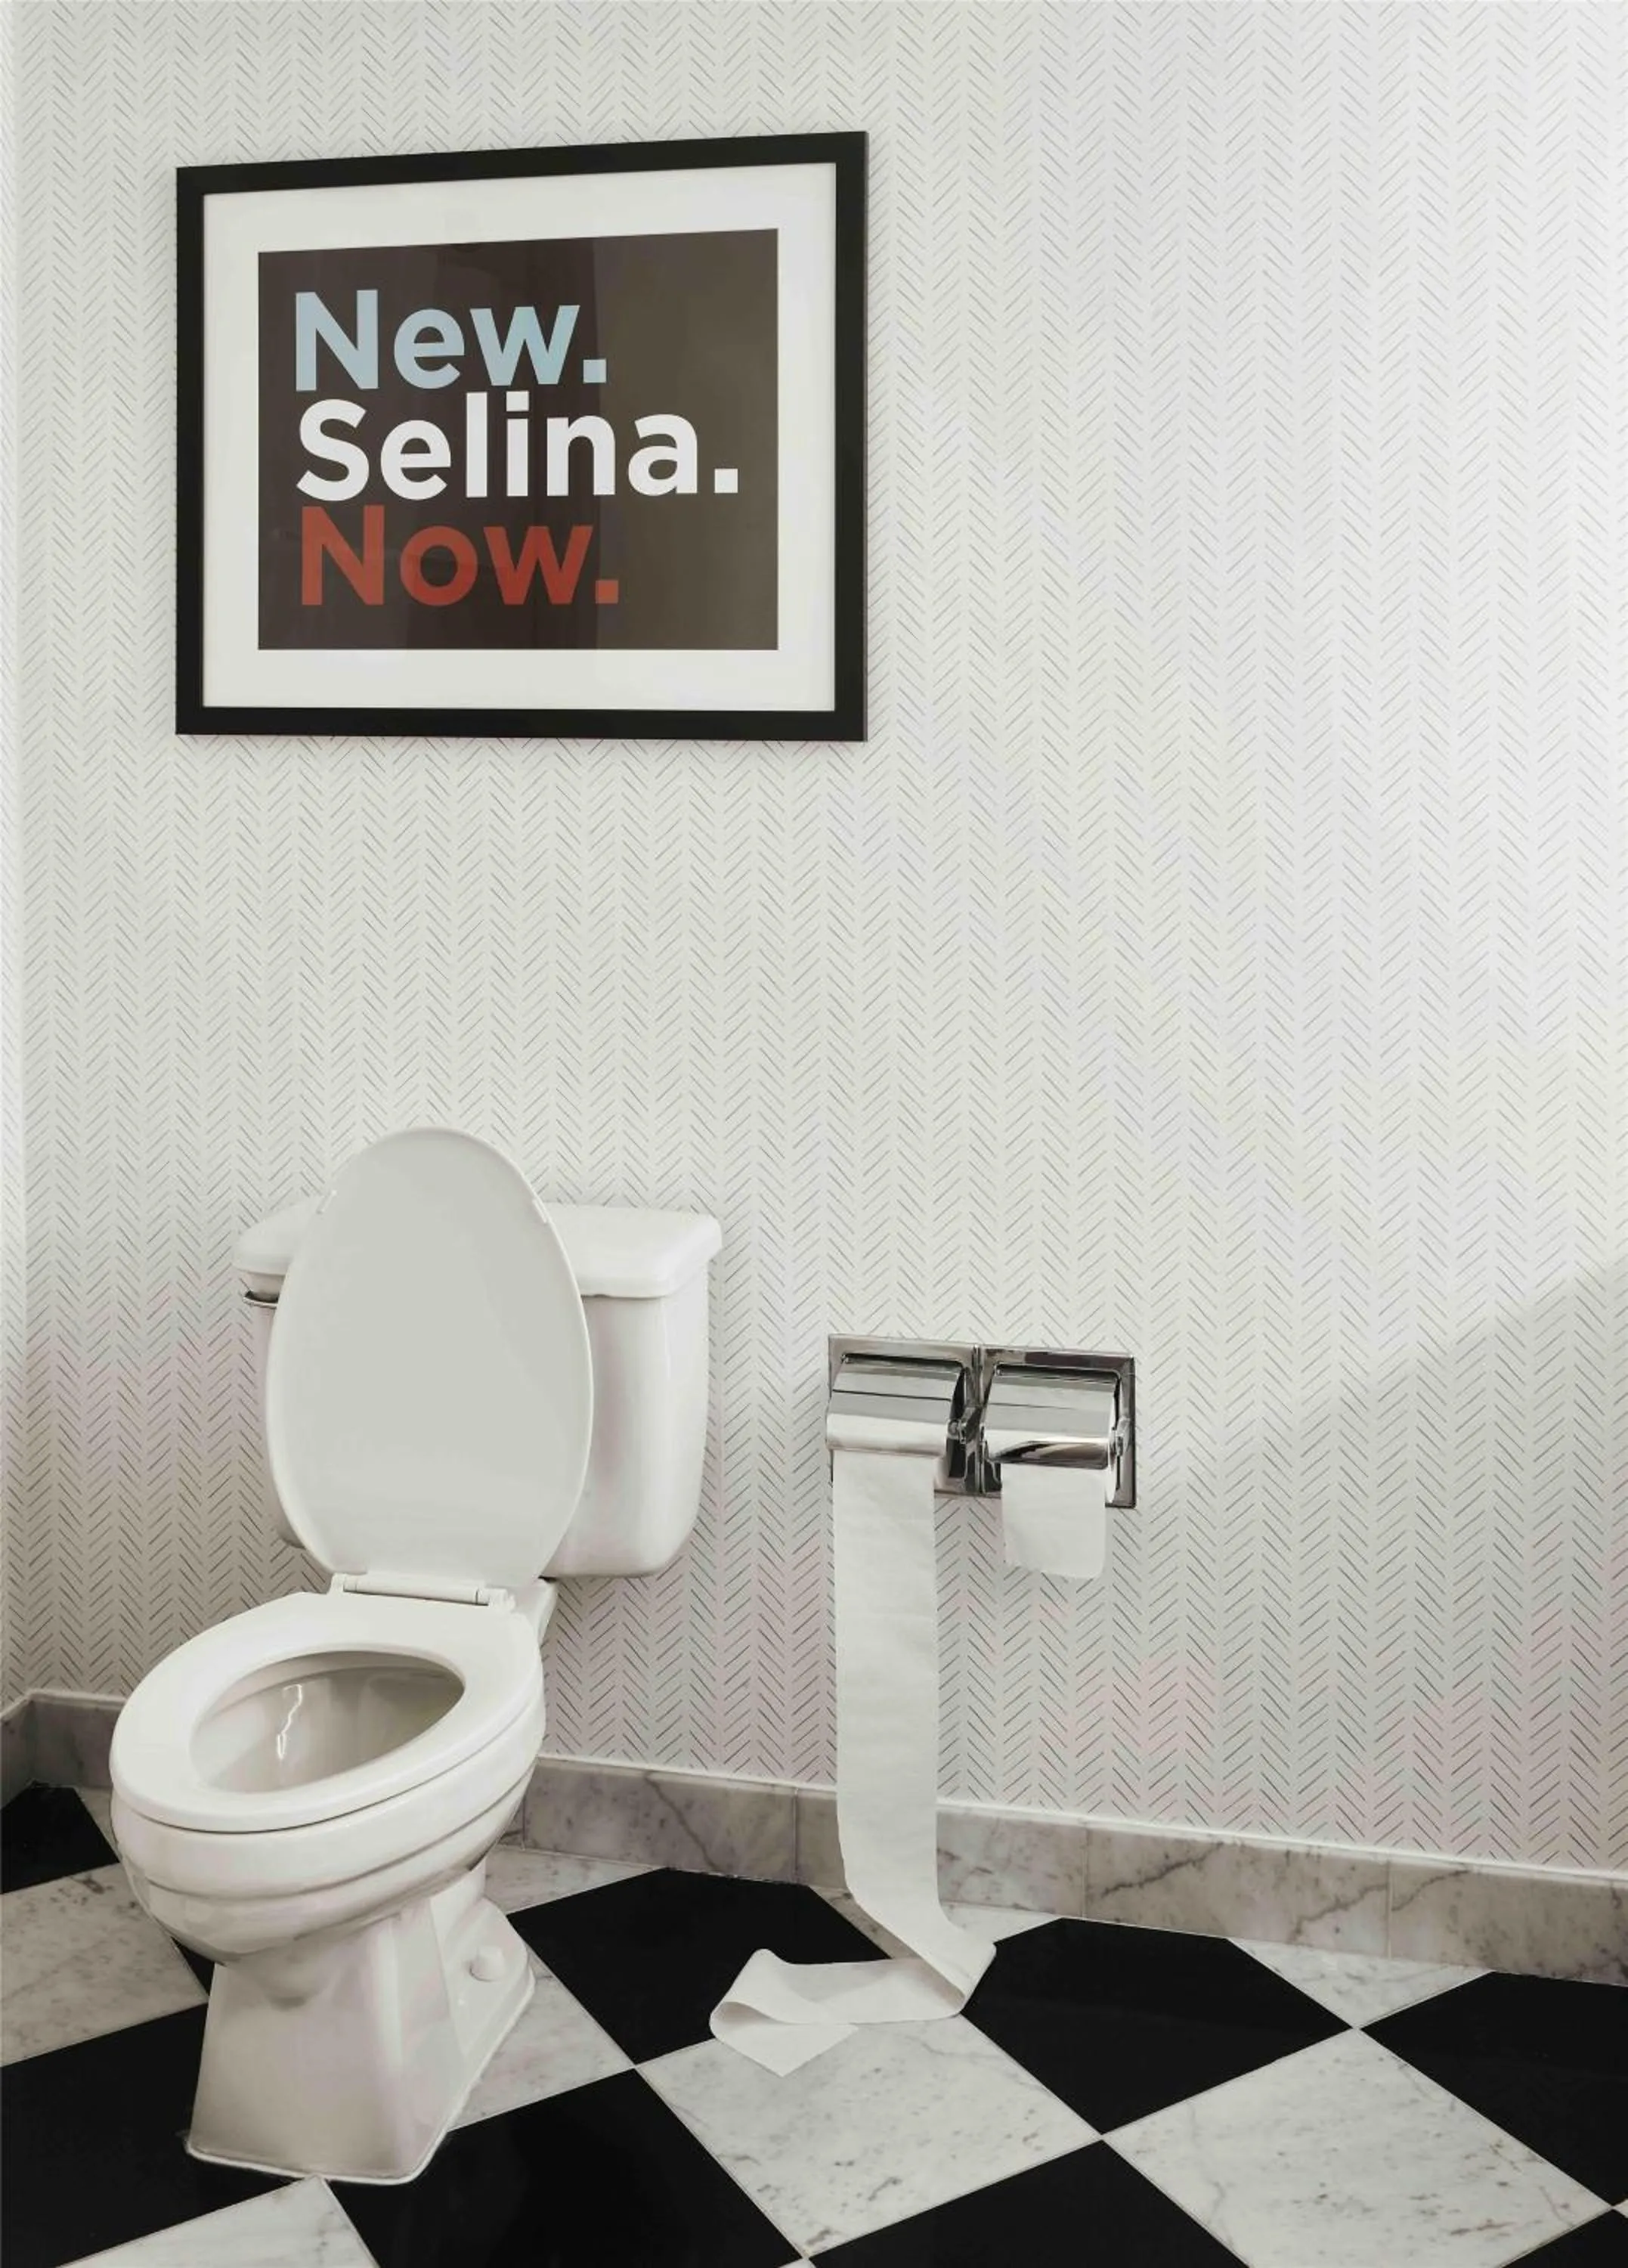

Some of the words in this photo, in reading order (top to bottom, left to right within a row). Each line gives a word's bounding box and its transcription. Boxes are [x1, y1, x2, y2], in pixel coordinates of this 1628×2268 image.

[295, 289, 607, 392] New.
[296, 390, 739, 502] Selina.
[302, 504, 619, 606] Now.
